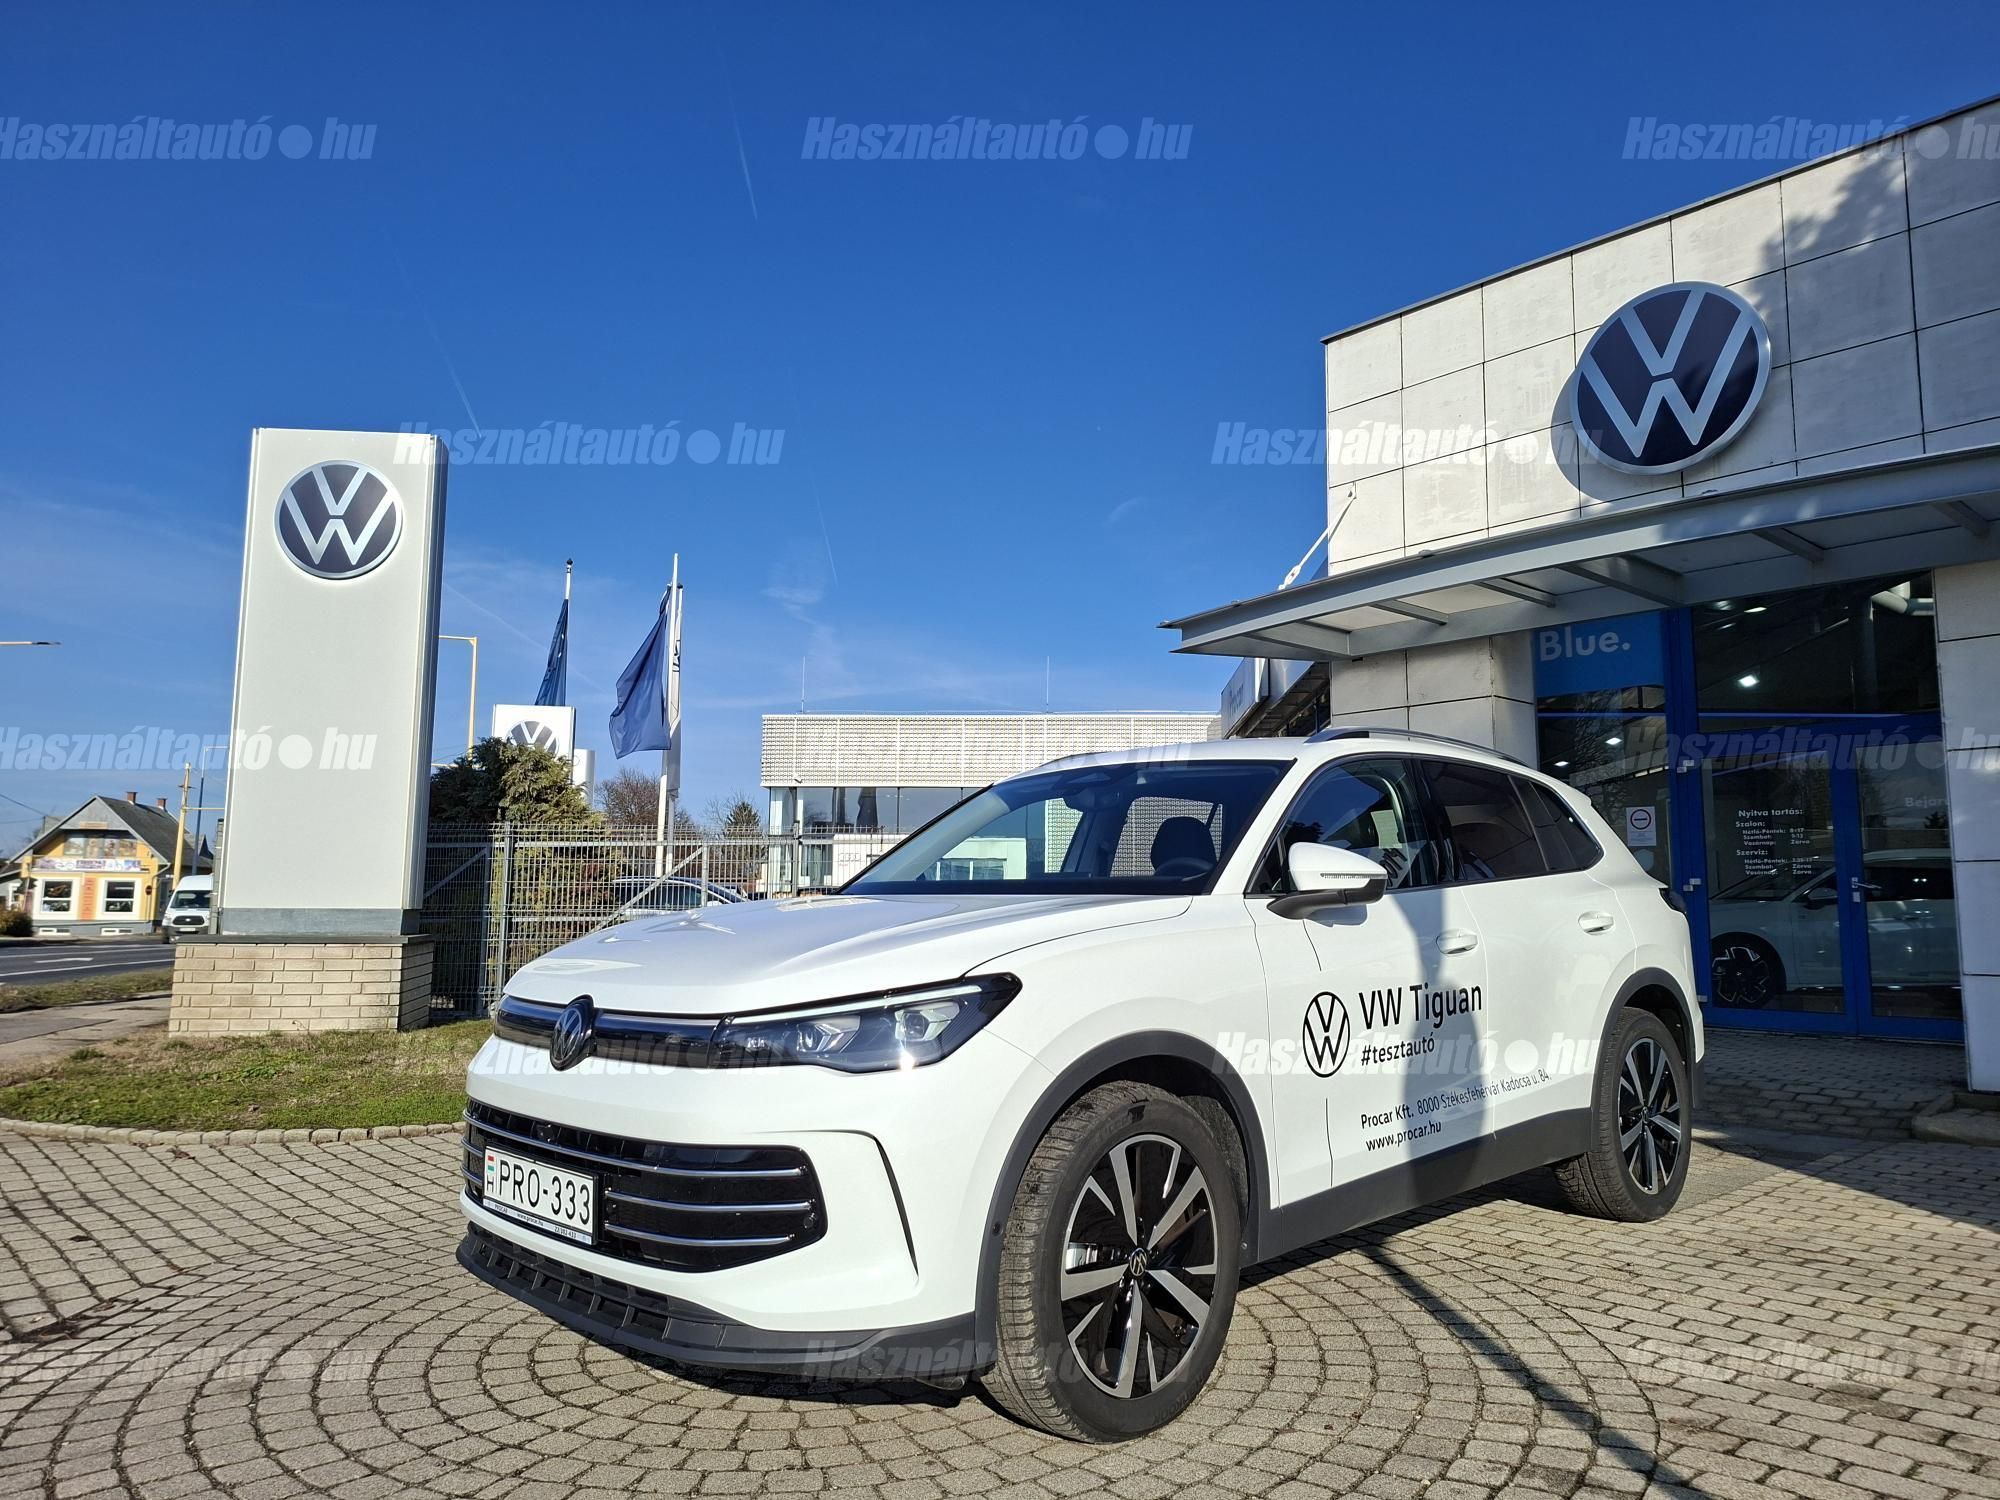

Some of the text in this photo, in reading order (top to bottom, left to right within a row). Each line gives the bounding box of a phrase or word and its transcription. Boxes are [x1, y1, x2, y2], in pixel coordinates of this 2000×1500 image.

[1540, 626, 1631, 662] Blue.
[1738, 810, 1769, 818] Nyitva
[1359, 982, 1482, 1030] VW Tiguan
[1361, 1032, 1436, 1066] #tesztautó
[1361, 1109, 1393, 1129] Procar
[1395, 1104, 1414, 1121] Kft.
[1417, 1096, 1440, 1115] 8000
[1441, 1081, 1500, 1110] Székesfehérvár
[1501, 1075, 1531, 1093] Kadocsa
[1532, 1076, 1539, 1086] u.
[1366, 1120, 1442, 1151] www.procar.hu
[486, 1159, 590, 1225] H PRO-333
